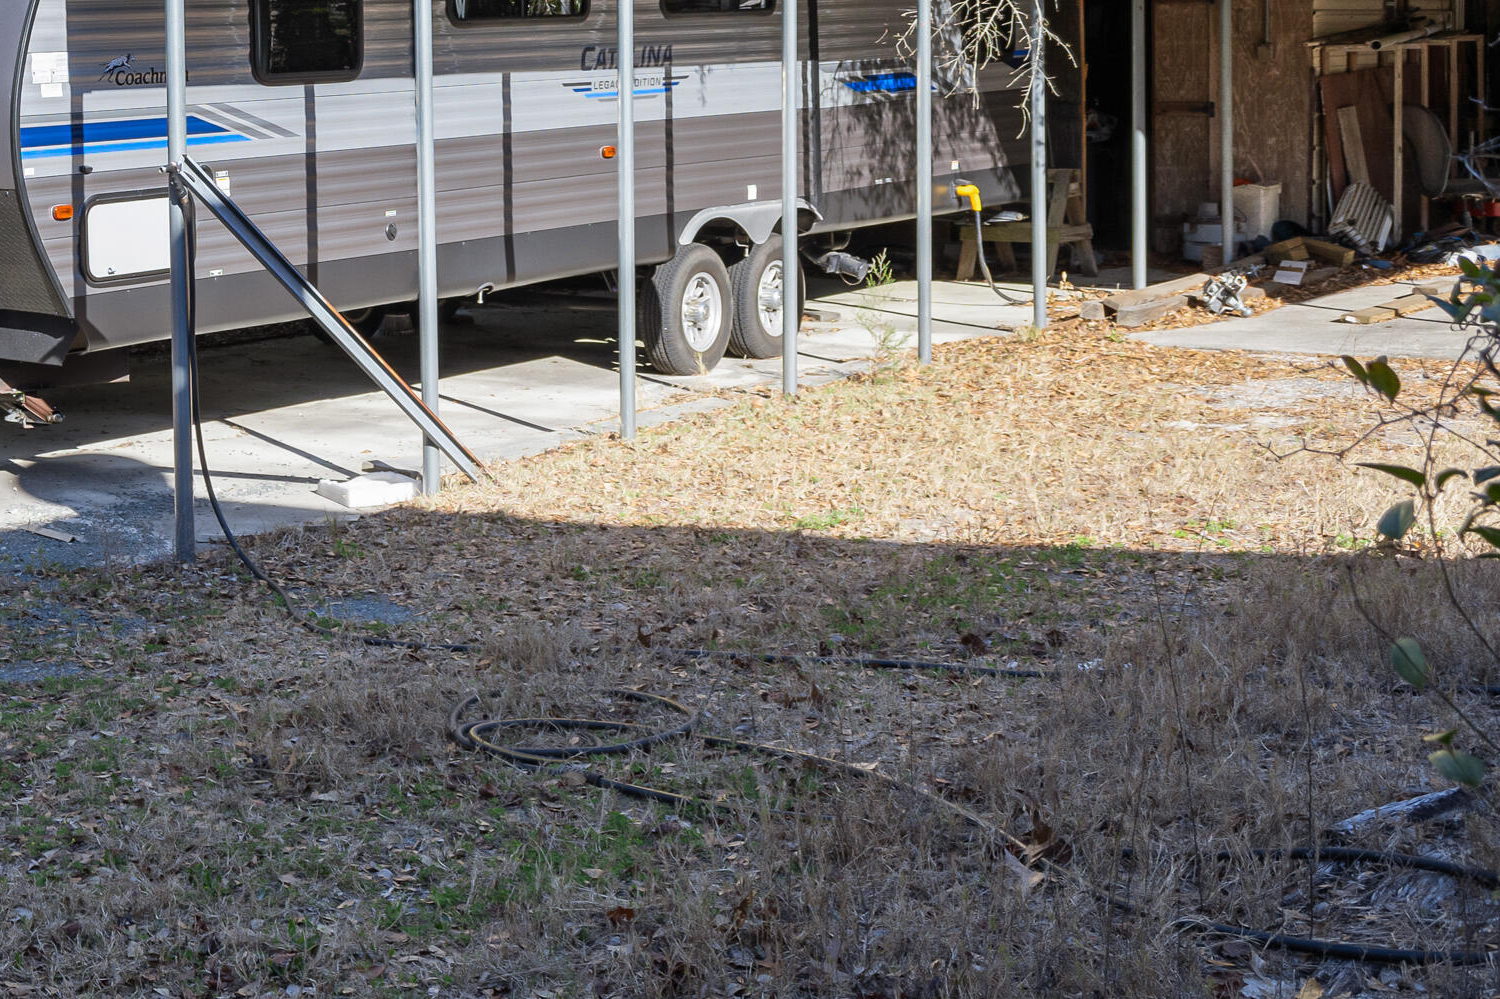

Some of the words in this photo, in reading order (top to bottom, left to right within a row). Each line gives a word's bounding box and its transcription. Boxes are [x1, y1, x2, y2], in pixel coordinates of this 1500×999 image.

[580, 44, 673, 71] CATINA
[115, 66, 189, 86] Coachm
[593, 79, 619, 90] LEGA
[633, 77, 661, 88] DITION
